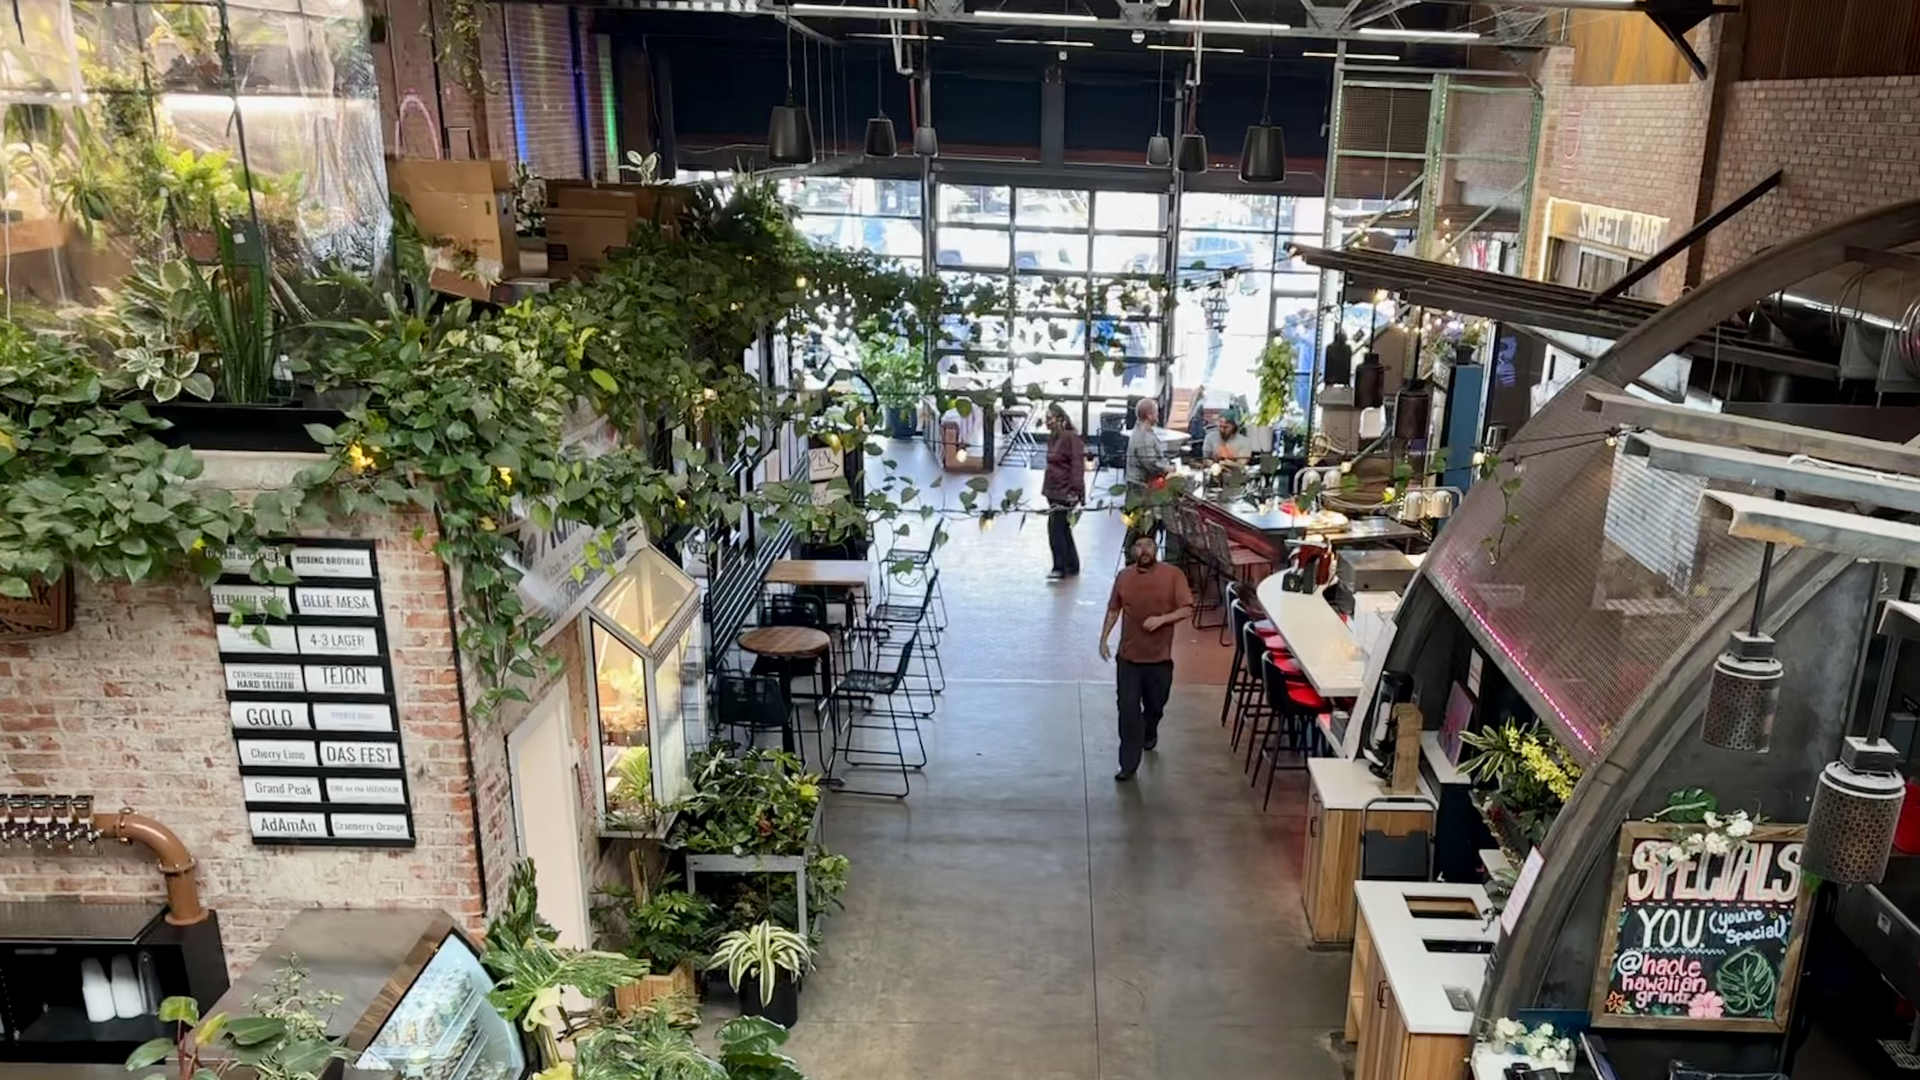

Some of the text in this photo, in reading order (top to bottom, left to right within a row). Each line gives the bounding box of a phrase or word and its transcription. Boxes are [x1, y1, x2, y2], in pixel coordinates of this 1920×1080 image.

[1578, 205, 1662, 255] SWEET BAR
[302, 594, 370, 609] BLUE MESA
[310, 633, 364, 648] 4-3 LAGER
[320, 666, 368, 685] TEJON
[237, 681, 260, 689] HARD
[246, 708, 293, 727] GOLD
[251, 748, 281, 760] Cherry
[326, 746, 393, 763] DAS FEST
[254, 781, 313, 796] Grand Peak
[261, 817, 317, 832] AdAmAn
[376, 822, 405, 833] Orange
[1628, 840, 1802, 902] SPECIALS
[1617, 951, 1702, 977] @haole
[1622, 973, 1707, 993] hawaiian
